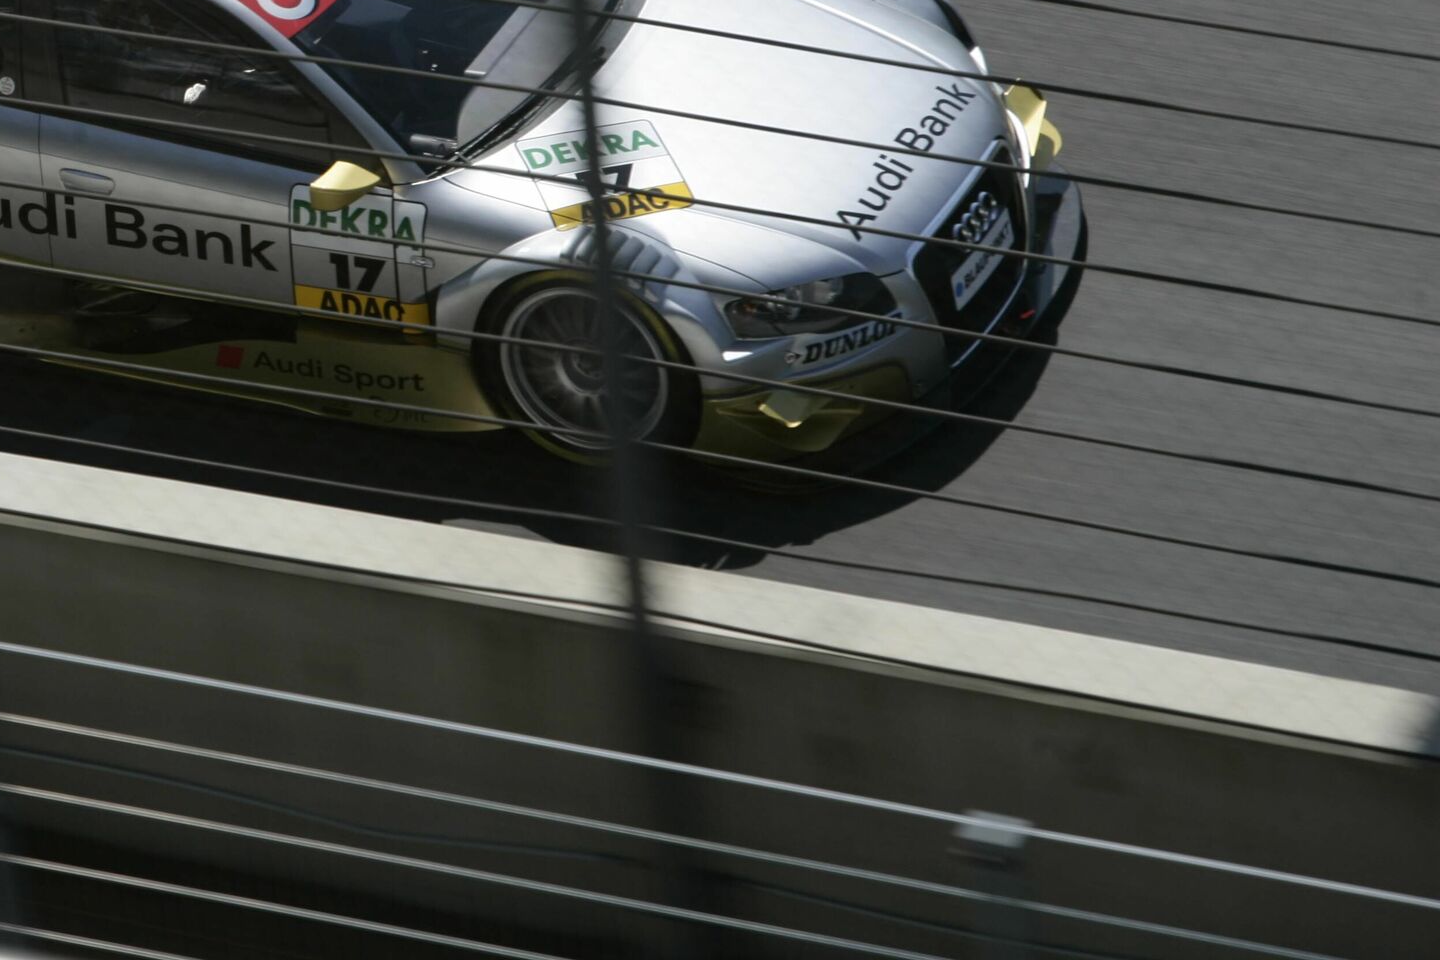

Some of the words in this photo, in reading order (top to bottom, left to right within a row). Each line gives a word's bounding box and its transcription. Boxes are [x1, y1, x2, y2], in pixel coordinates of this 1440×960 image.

[836, 154, 914, 242] Audi
[894, 83, 976, 152] Bank
[105, 203, 279, 272] Bank
[329, 252, 386, 292] 17
[320, 291, 405, 323] ADAC
[253, 351, 323, 378] Audi
[334, 364, 425, 391] Sport
